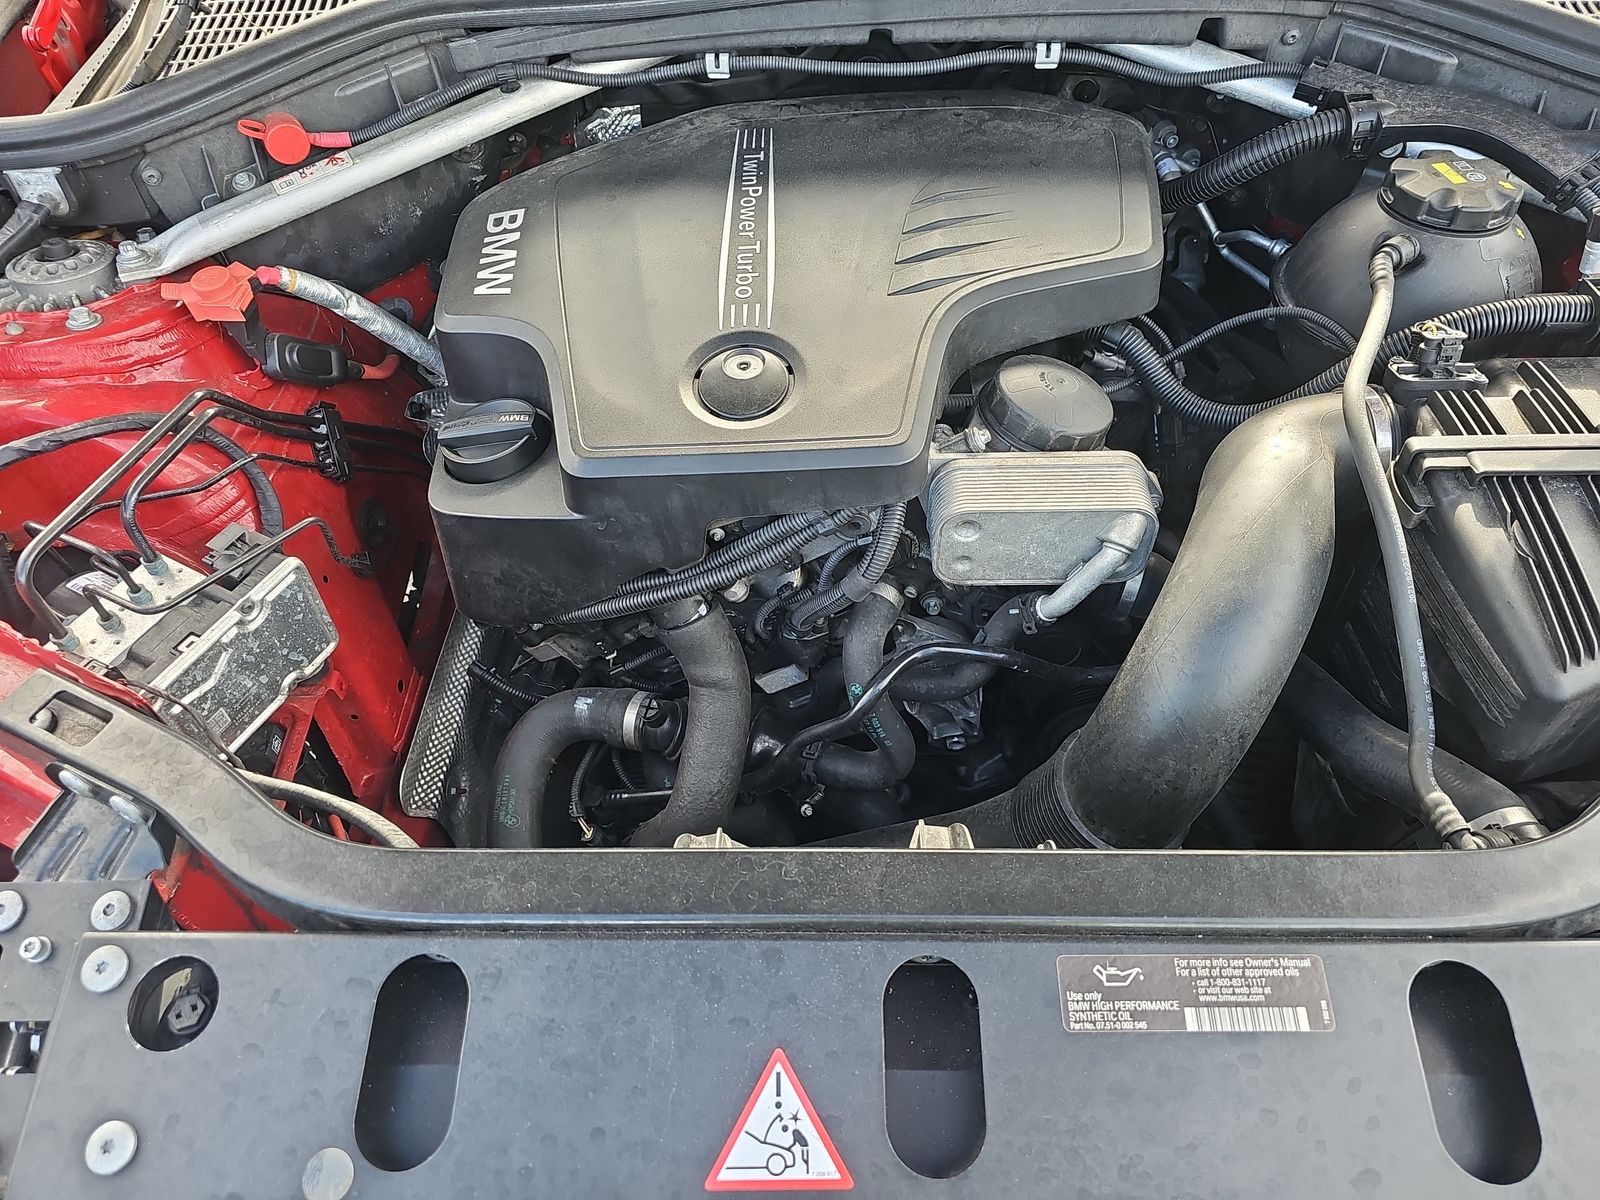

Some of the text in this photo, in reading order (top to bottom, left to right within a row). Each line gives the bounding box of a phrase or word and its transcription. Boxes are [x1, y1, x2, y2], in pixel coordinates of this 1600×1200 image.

[733, 150, 766, 299] TwinPower Turbo
[473, 207, 525, 296] BMW
[498, 414, 529, 423] BMW
[1416, 638, 1426, 668] POLAND
[1174, 957, 1311, 967] For more info see Owner's Manual
[1175, 967, 1190, 977] For
[1198, 967, 1210, 977] list
[1211, 967, 1220, 977] of
[1221, 967, 1243, 977] other
[1244, 967, 1284, 978] approved
[1284, 967, 1300, 977] oils
[1196, 978, 1266, 986] call 1-800-831-1117
[1206, 986, 1221, 994] visit
[1234, 986, 1250, 994] web
[1250, 986, 1263, 994] site
[1263, 986, 1272, 994] at
[1066, 991, 1102, 1002] Use only
[1198, 994, 1265, 1002] www.bmwusa.com
[1067, 1000, 1180, 1011] BMW HIGH PERFORMANCE
[1069, 1011, 1133, 1021] SYNTHETIC OIL
[1070, 1021, 1083, 1030] Part
[1084, 1021, 1095, 1030] No.
[1121, 1021, 1134, 1029] 002
